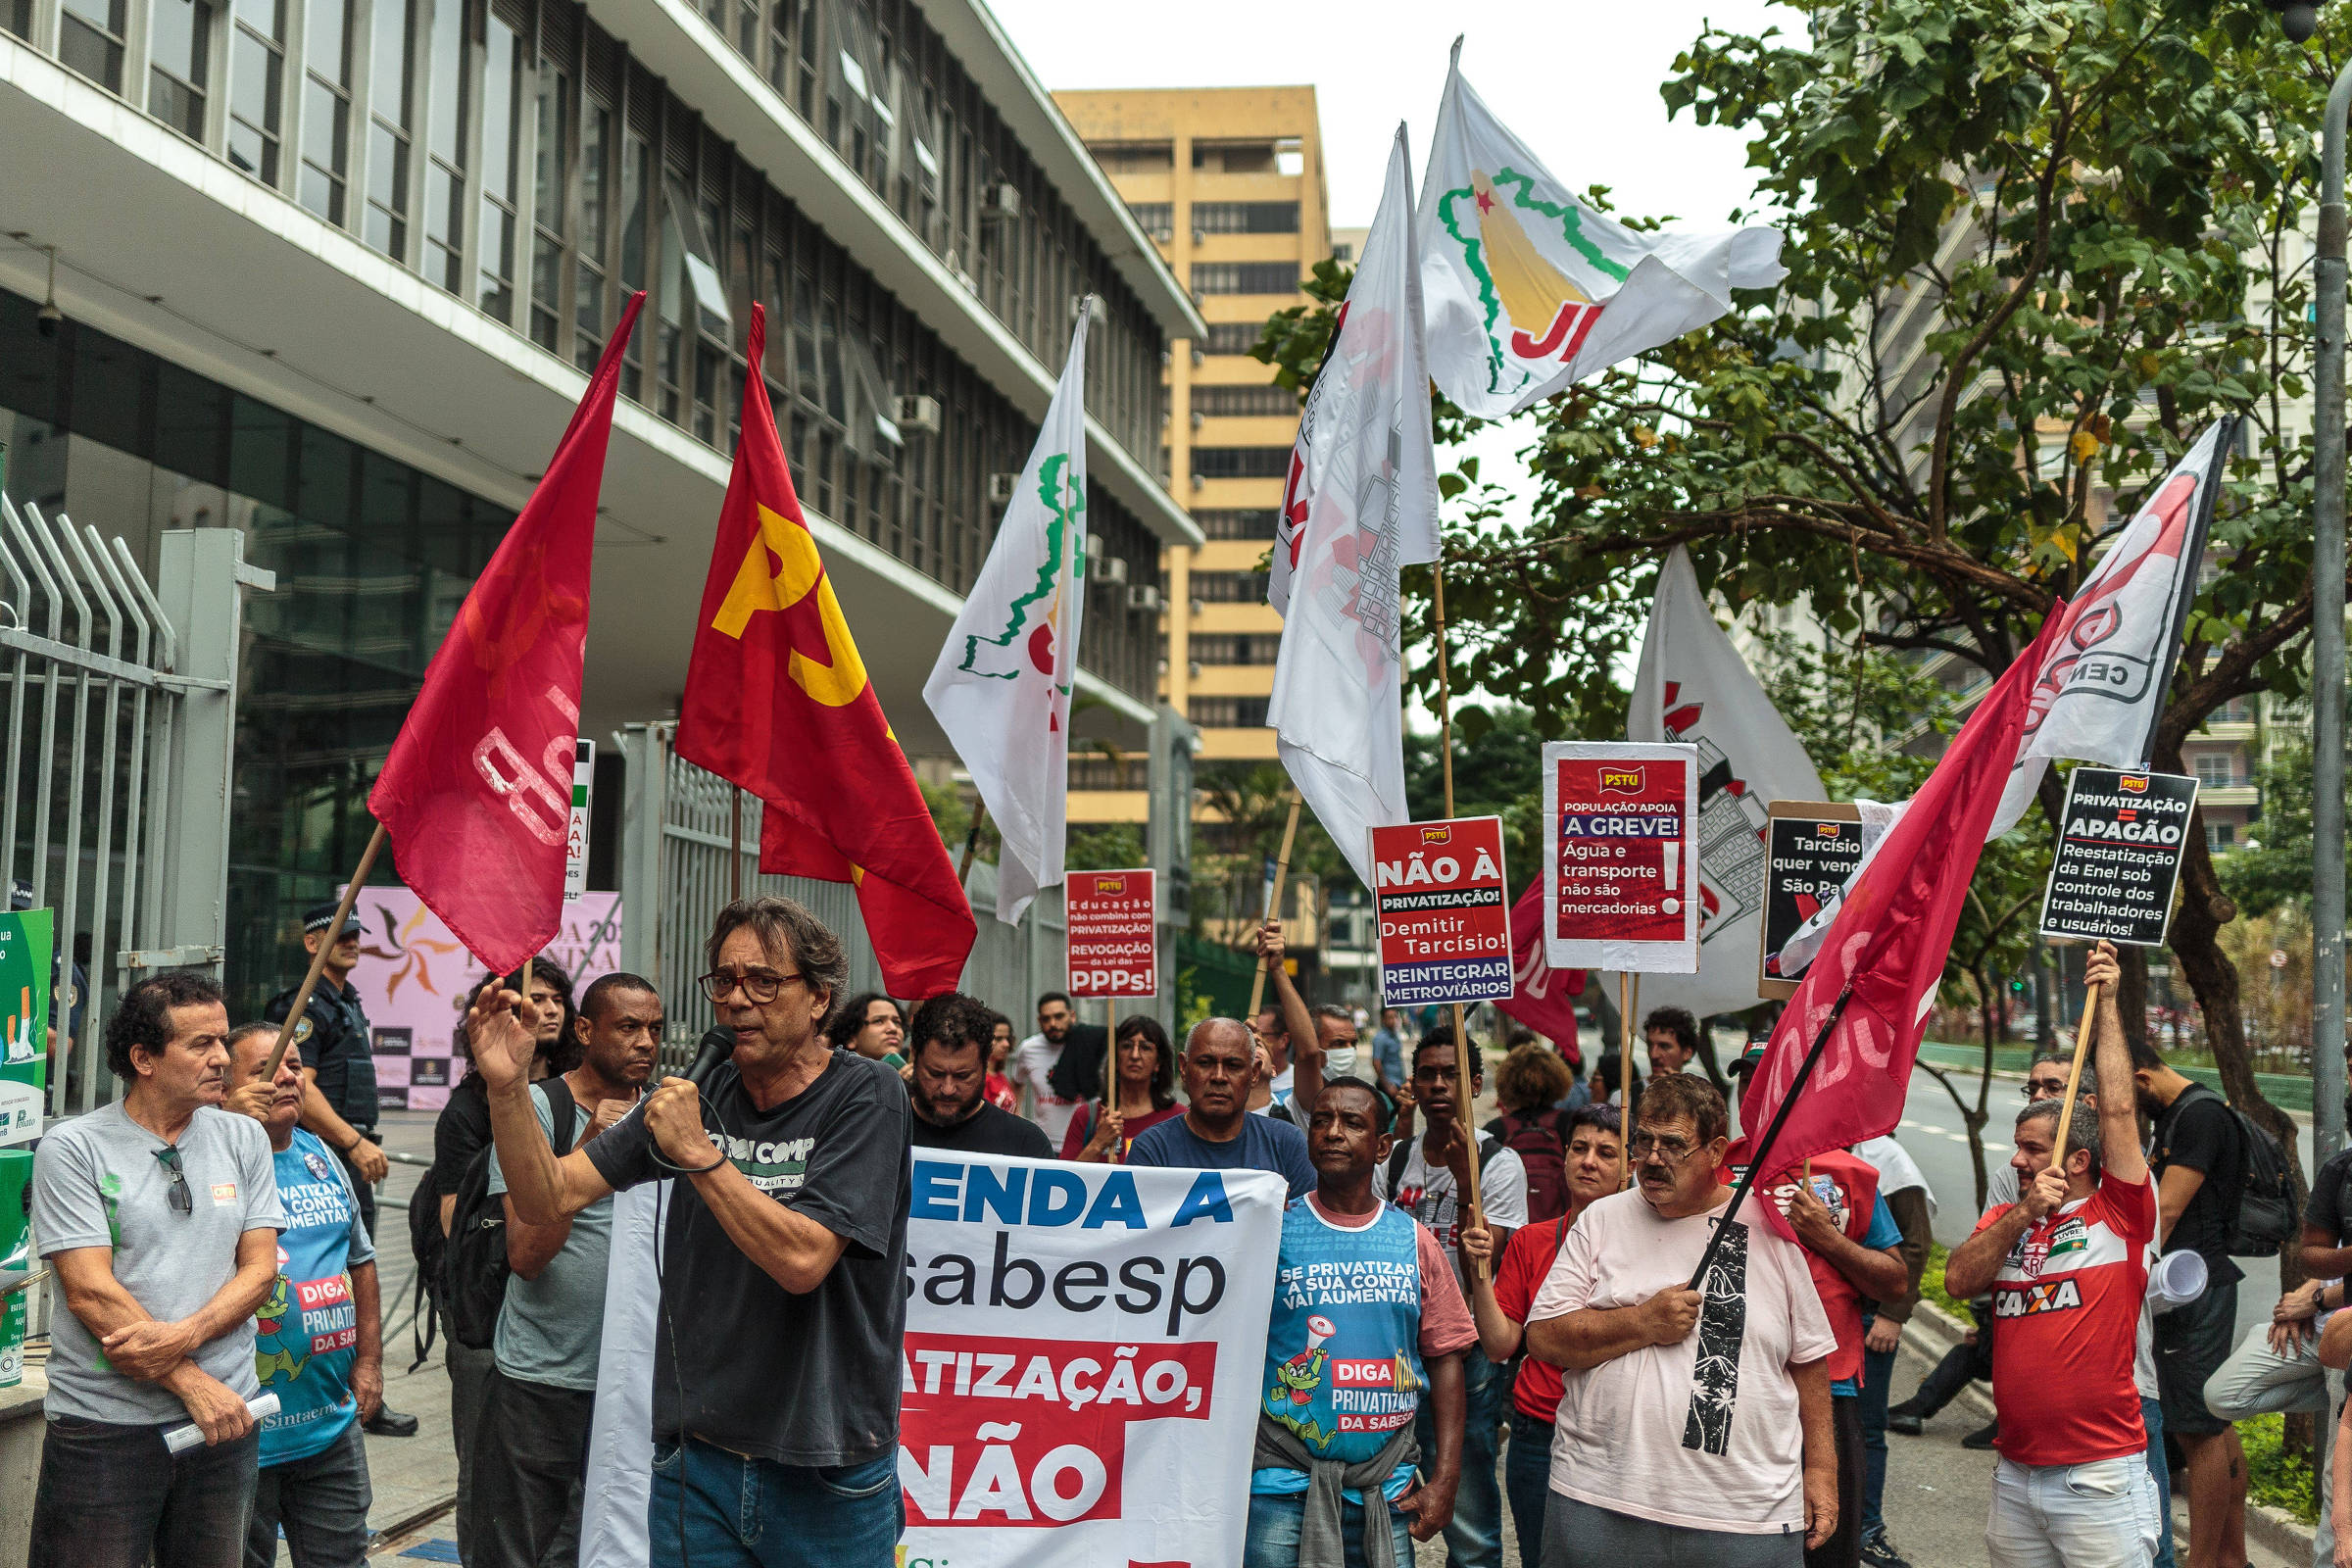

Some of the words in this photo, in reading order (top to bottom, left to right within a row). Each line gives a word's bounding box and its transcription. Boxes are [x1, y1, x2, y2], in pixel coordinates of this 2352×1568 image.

[1605, 774, 1638, 786] PSTU
[2123, 779, 2144, 789] PSTU
[1564, 802, 1637, 813] POPULAÇÃO
[1639, 804, 1677, 812] APOIA
[2073, 793, 2186, 813] PRIVATIZAÇÃO
[1425, 831, 1446, 840] PSTU
[1564, 817, 1584, 835] A
[1590, 817, 1679, 836] GREVE!
[2066, 817, 2180, 844] APAGÃO
[1563, 841, 1609, 859] Água
[1615, 847, 1626, 858] e
[1794, 837, 1860, 854] Tarcísio
[1772, 858, 1813, 871] quer
[2064, 844, 2175, 867] Reestatização
[1376, 852, 1460, 887] NÃO
[1471, 847, 1500, 880] À
[1563, 864, 1657, 880] transporte
[2059, 861, 2079, 875] da
[2083, 864, 2118, 879] Enel
[2122, 869, 2151, 882] sob
[1099, 881, 1122, 891] PSTU
[1562, 884, 1591, 896] não
[1594, 884, 1620, 896] são
[1782, 878, 1814, 893] São
[2055, 882, 2122, 898] controle
[2126, 887, 2155, 901] dos
[1070, 899, 1151, 911] Educação
[1382, 890, 1500, 909] PRIVATIZAÇÃO!
[1562, 903, 1656, 914] mercadorias
[2051, 898, 2163, 920] trabalhadores
[1070, 912, 1088, 921] não
[1070, 922, 1152, 935] PRIVATIZAÇÃO!
[1382, 917, 1464, 937] Demitir
[2047, 917, 2057, 927] e
[2062, 918, 2133, 936] usuários!
[1071, 942, 1152, 956] REVOGAÇÃO
[1404, 933, 1506, 955] Tarcísio!
[1071, 969, 1152, 992] PPPs!
[1385, 962, 1508, 984] REINTEGRAR
[1387, 981, 1509, 1001] METROVIÁRIOS
[291, 1196, 344, 1213] CONTA
[1170, 1171, 1234, 1228] A
[1281, 1266, 1303, 1282] SE
[1308, 1261, 1415, 1277] PRIVATIZAR
[1288, 1281, 1300, 1296] A
[1305, 1276, 1347, 1292] SUA
[1350, 1275, 1413, 1290] CONTA
[1282, 1291, 1313, 1310] VAI
[1319, 1289, 1416, 1305] AUMENTAR
[1995, 1280, 2081, 1316] CAIXA
[315, 1336, 335, 1351] DA
[1338, 1363, 1392, 1381] DIGA
[1341, 1416, 1364, 1430] DA
[898, 1421, 1107, 1521] NÃO
